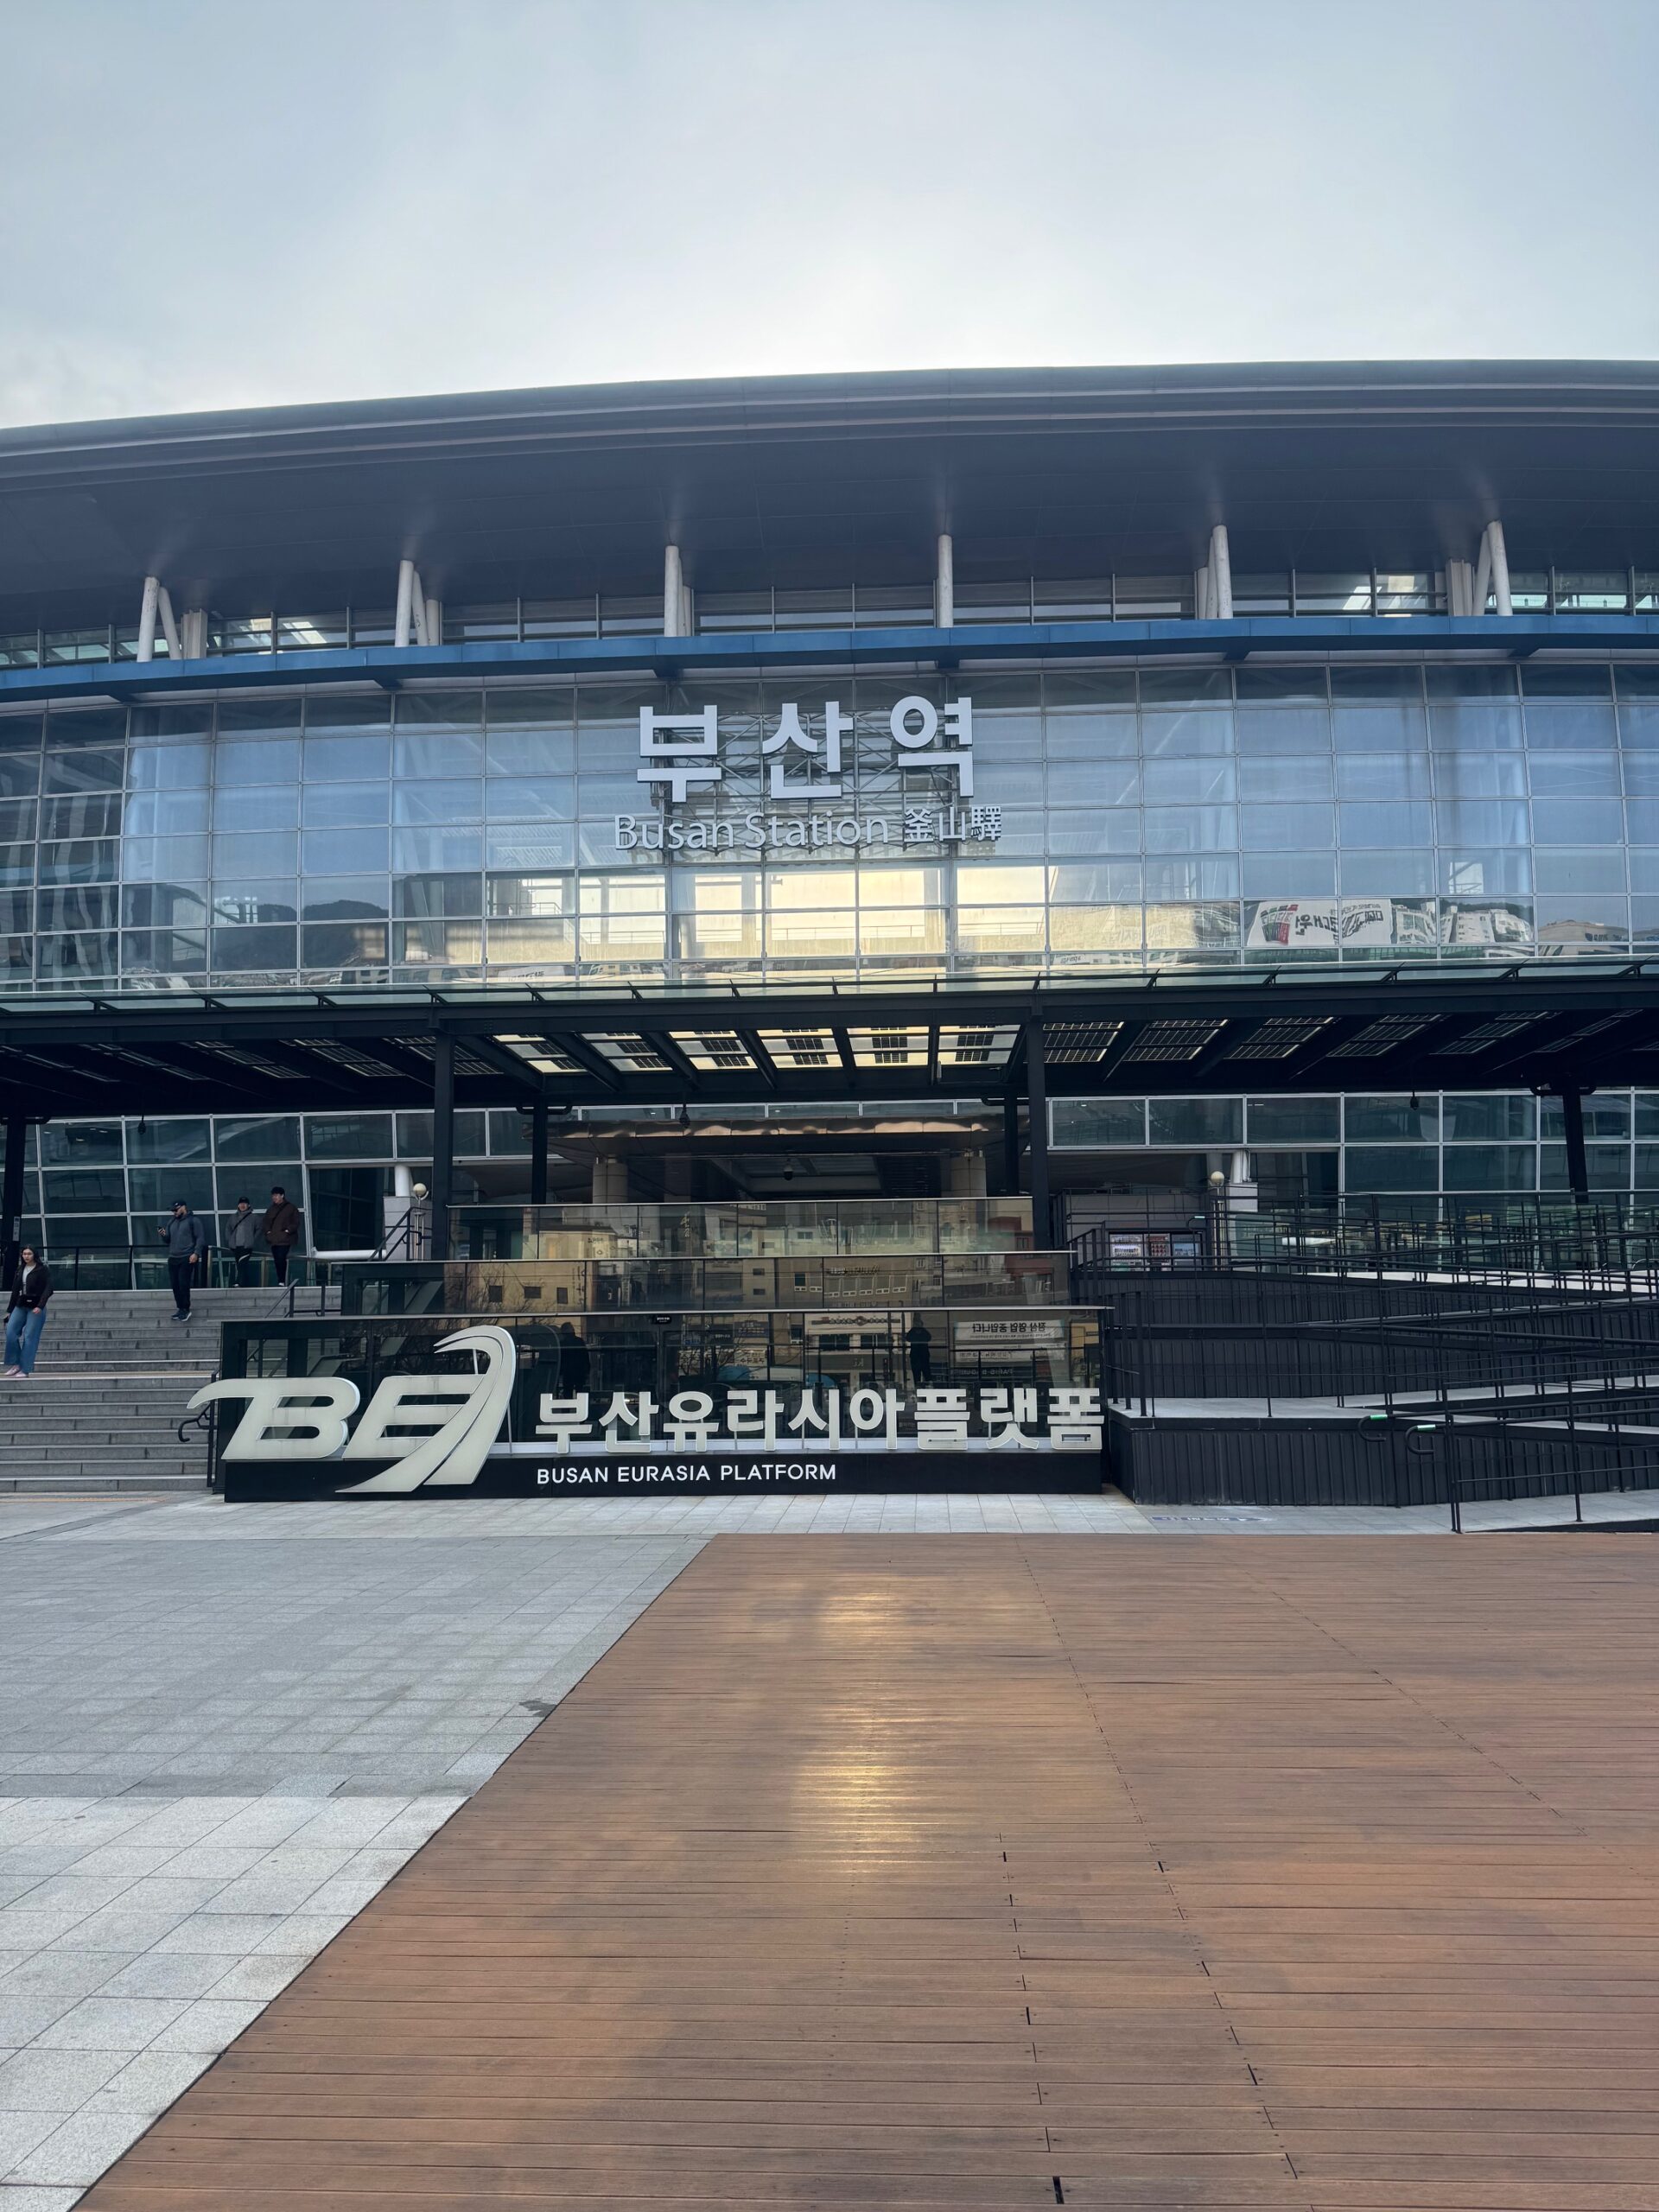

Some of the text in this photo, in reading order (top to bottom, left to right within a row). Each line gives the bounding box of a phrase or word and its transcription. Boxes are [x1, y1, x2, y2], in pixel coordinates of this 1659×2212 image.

[636, 696, 974, 803] 부산역
[614, 810, 889, 850] Busan Station
[904, 805, 1002, 843] 釜山驛
[535, 1387, 1106, 1454] 부산유라시아플랫폼
[537, 1464, 836, 1484] BUSAN EURASIA PLATFORM
